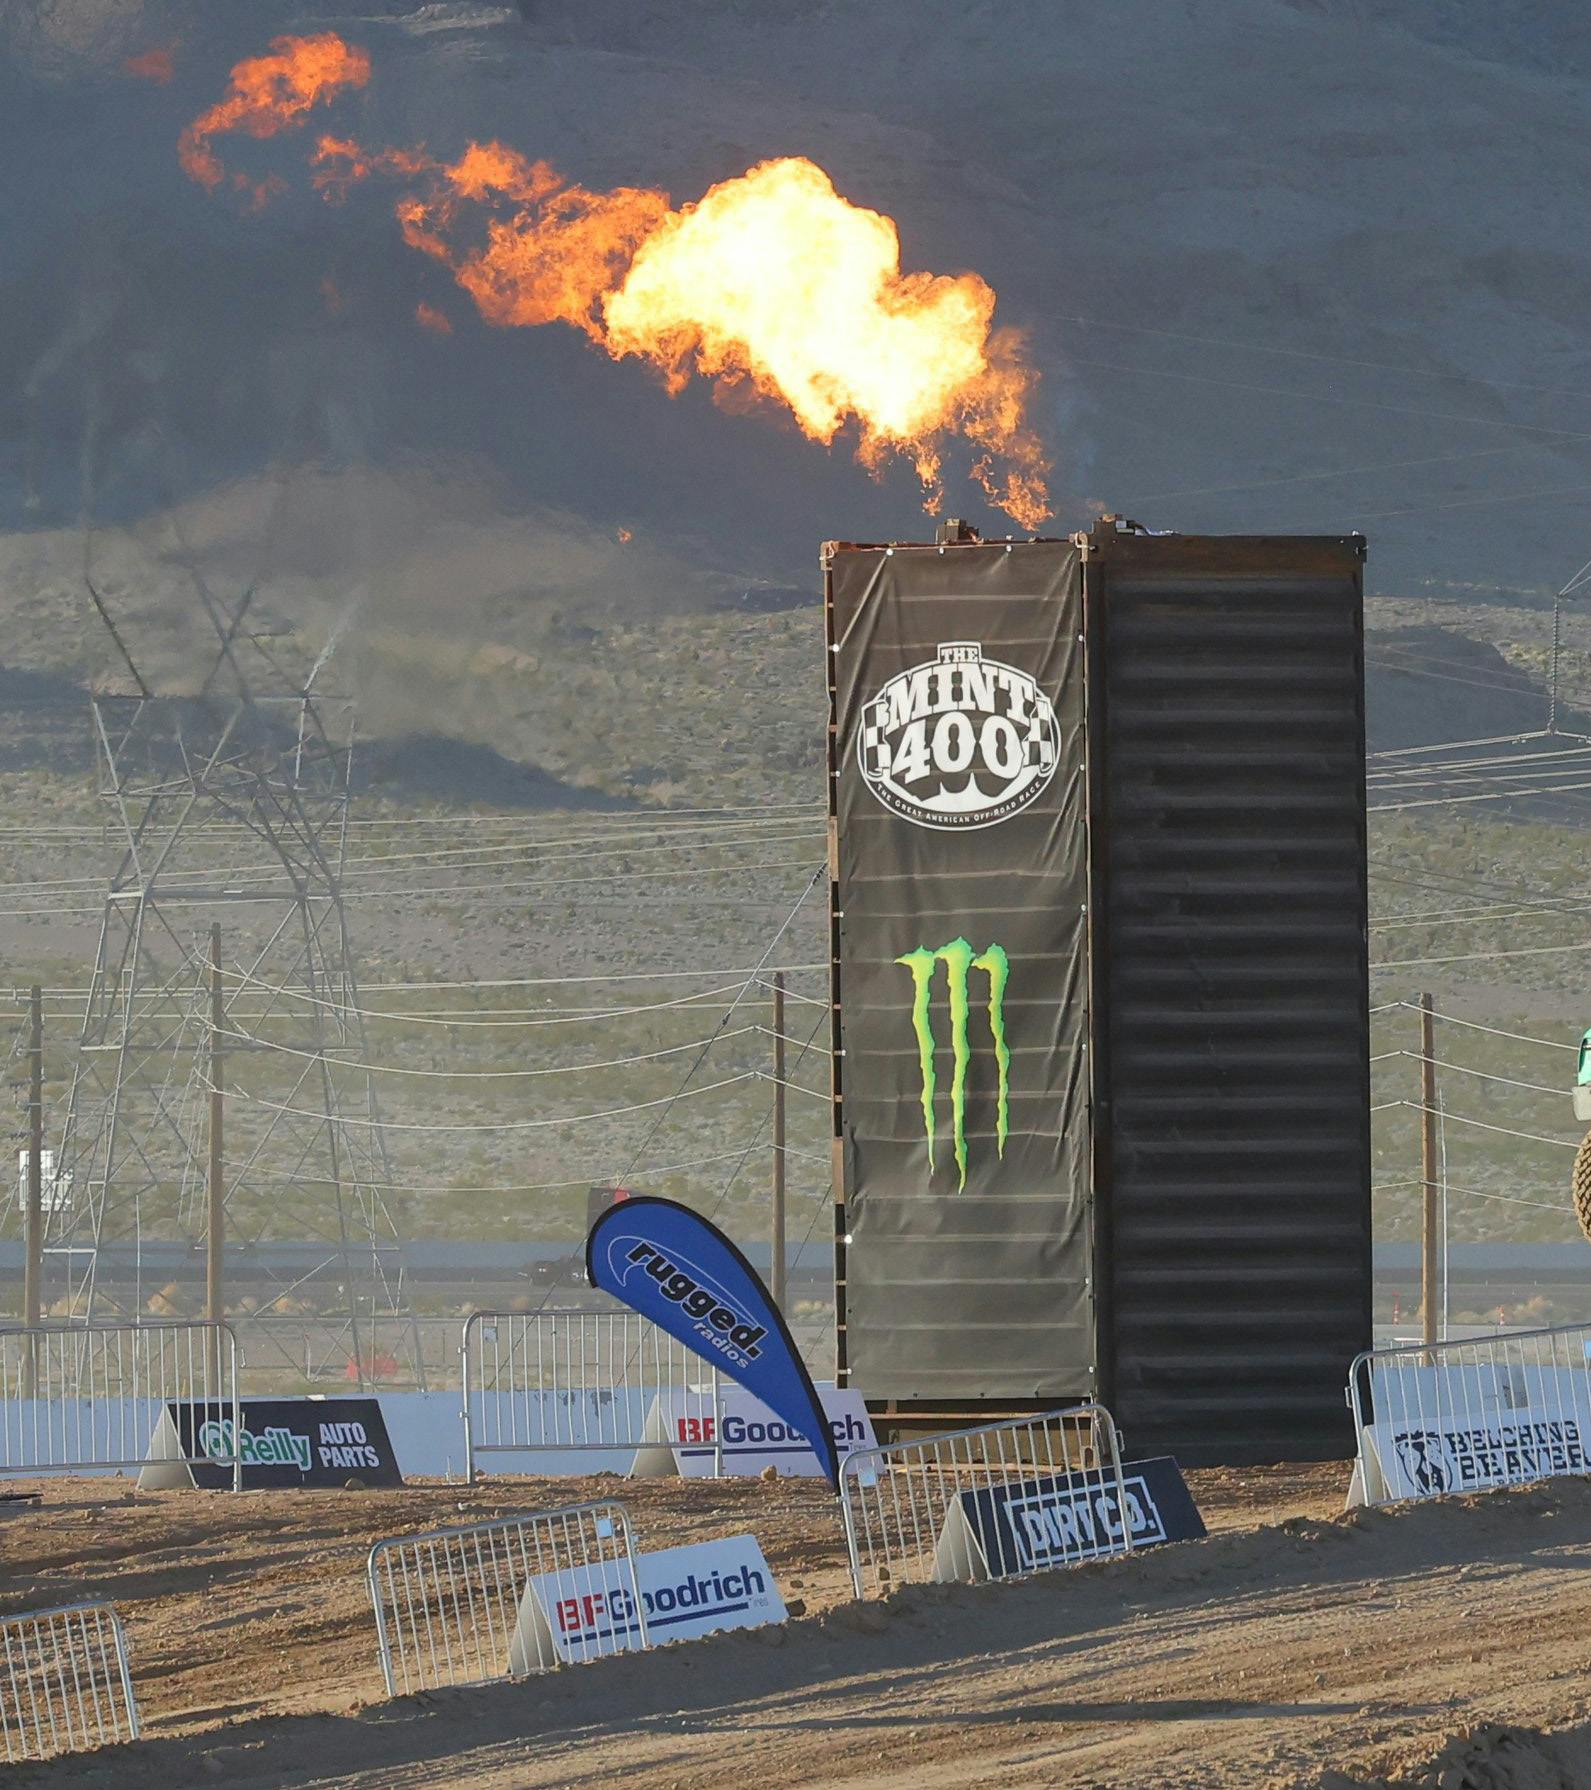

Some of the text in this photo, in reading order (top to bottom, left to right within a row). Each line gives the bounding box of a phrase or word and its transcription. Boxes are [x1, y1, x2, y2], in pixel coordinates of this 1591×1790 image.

[941, 648, 979, 663] THE
[885, 662, 1035, 735] MINT
[891, 711, 1025, 784] 400
[876, 783, 892, 801] THE
[926, 813, 970, 824] AMERICAN
[1018, 782, 1041, 802] RACE
[693, 1322, 749, 1369] radios
[318, 1422, 367, 1445] AUTO
[678, 1413, 865, 1442] BFGooch
[1444, 1421, 1580, 1454] BELCHING
[318, 1446, 380, 1468] PARTS
[1453, 1444, 1591, 1480] BEAVER
[556, 1564, 765, 1632] BFGoodrich
